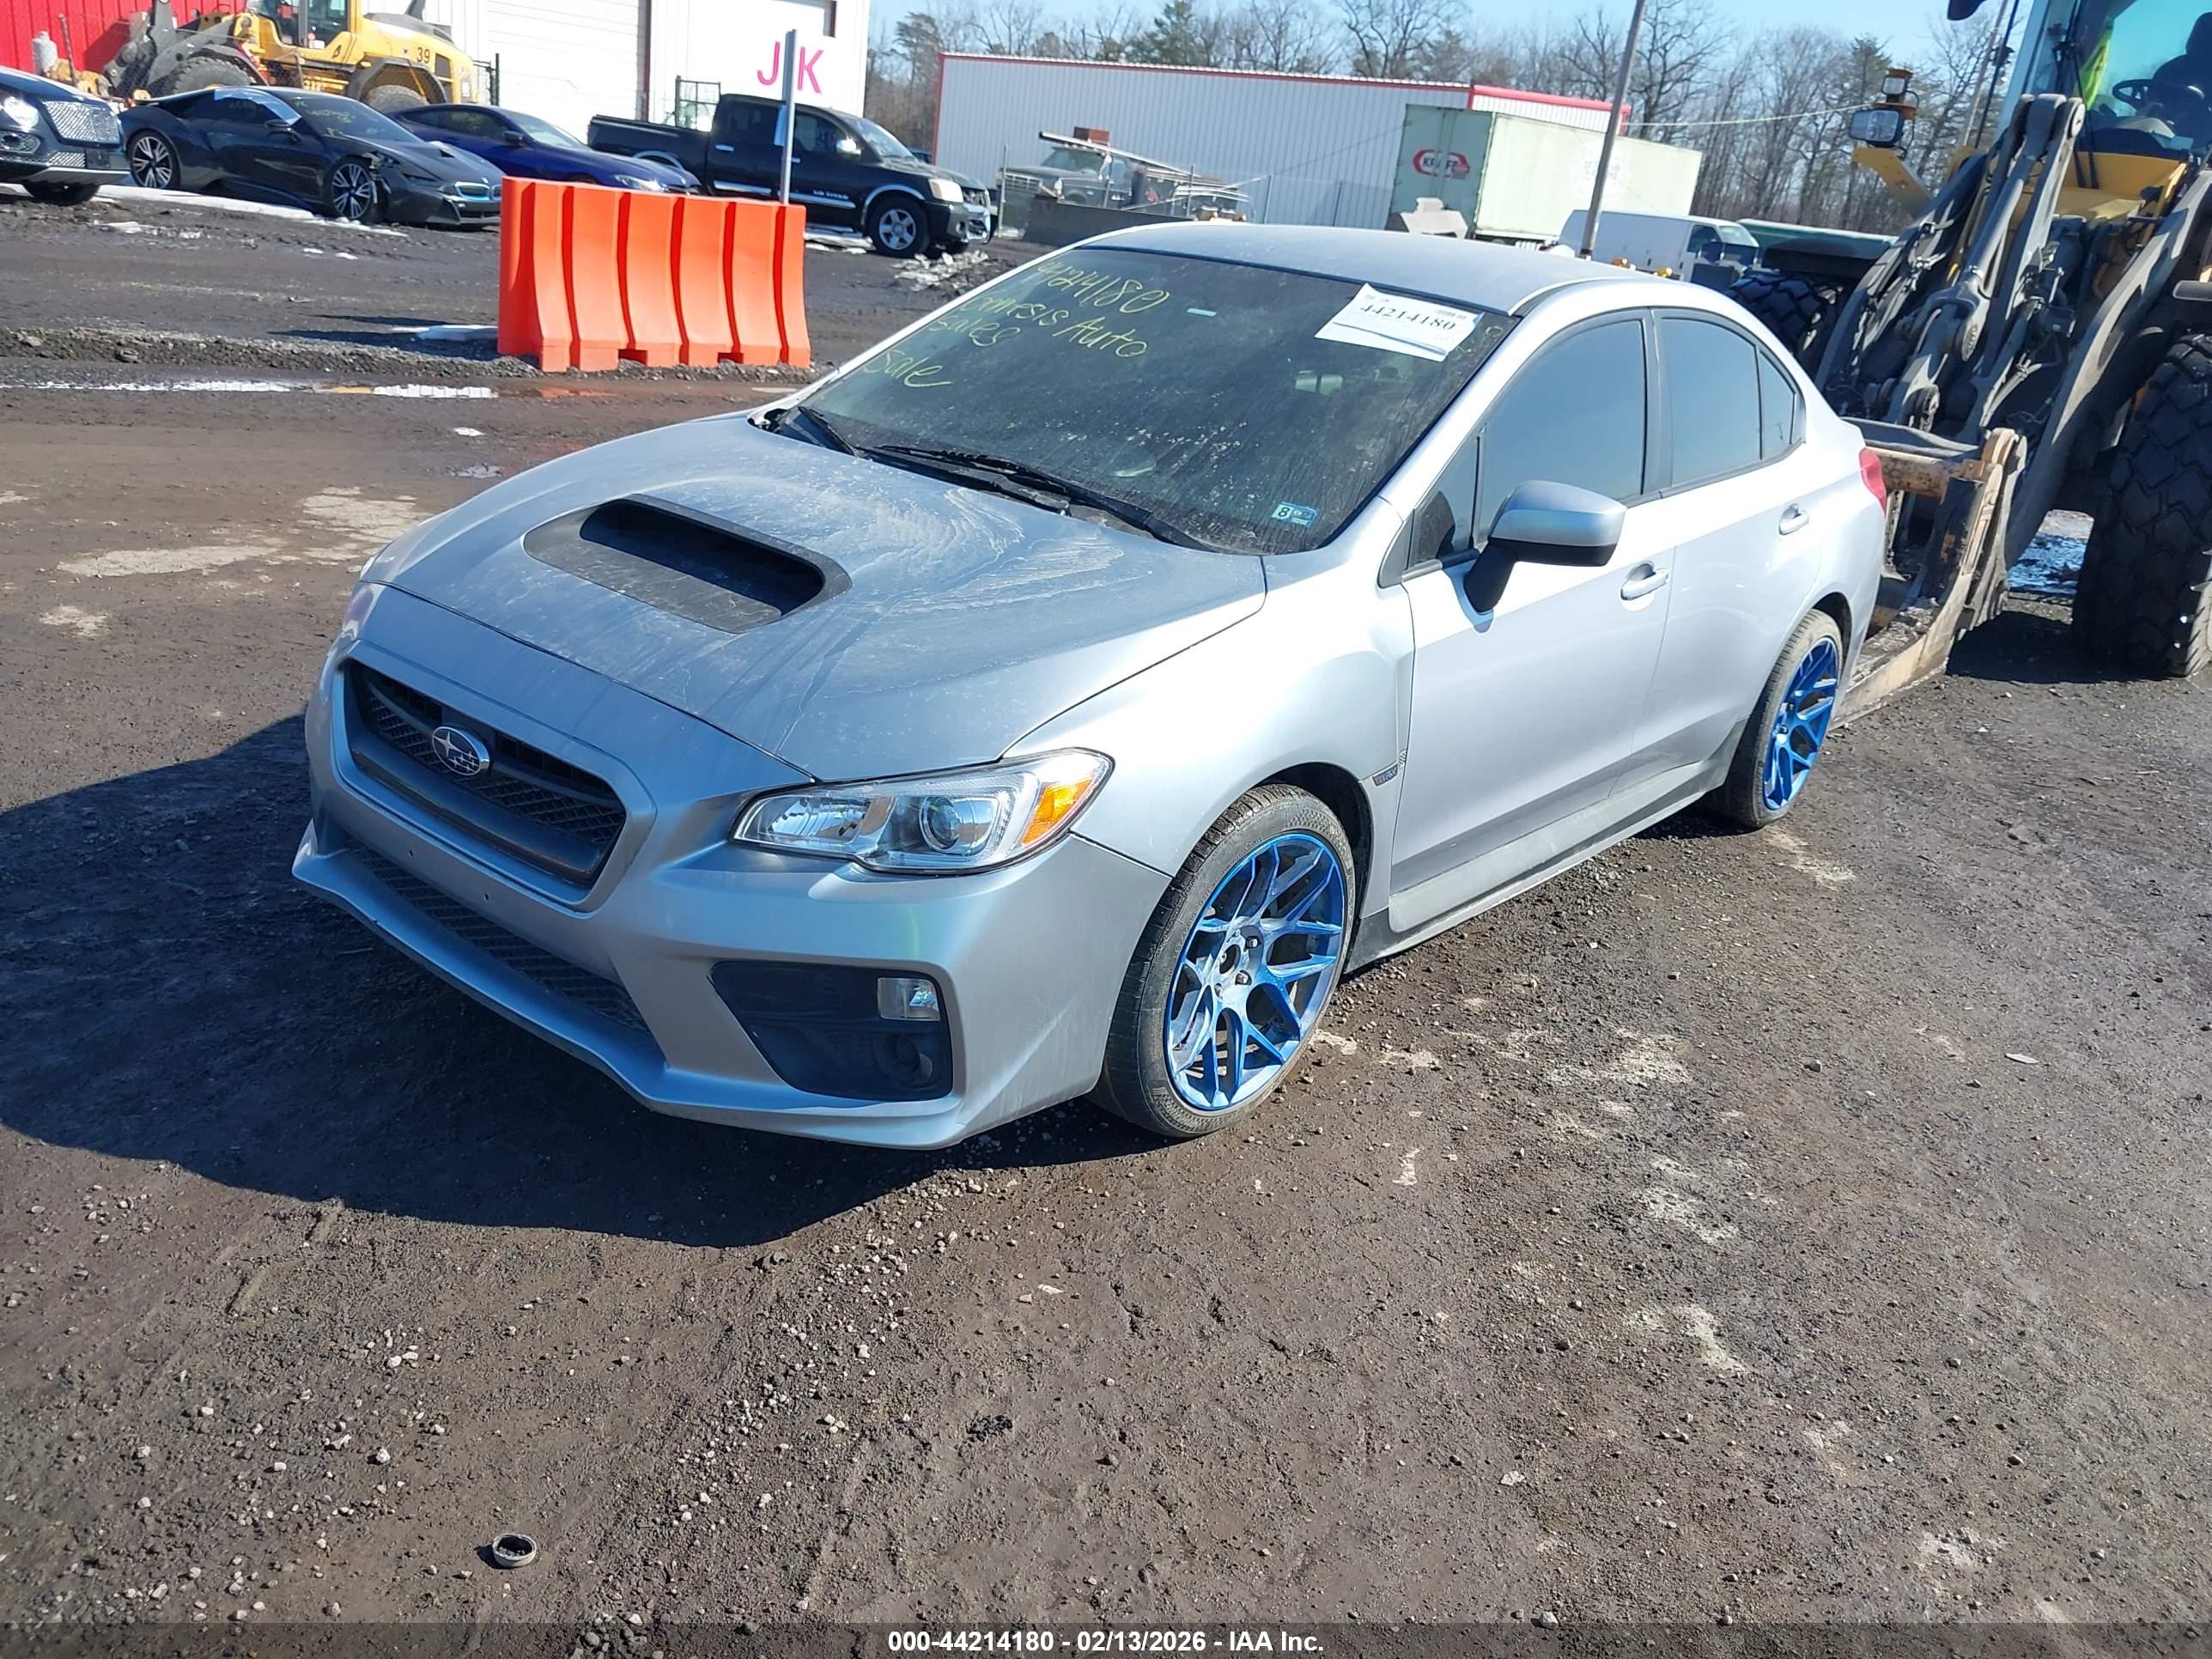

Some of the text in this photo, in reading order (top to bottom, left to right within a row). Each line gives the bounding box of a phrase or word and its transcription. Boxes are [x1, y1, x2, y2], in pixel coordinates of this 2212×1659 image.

[416, 46, 431, 64] 39
[1360, 304, 1456, 331] 44214180
[1052, 316, 1148, 357] Auto
[1278, 507, 1291, 518] 8
